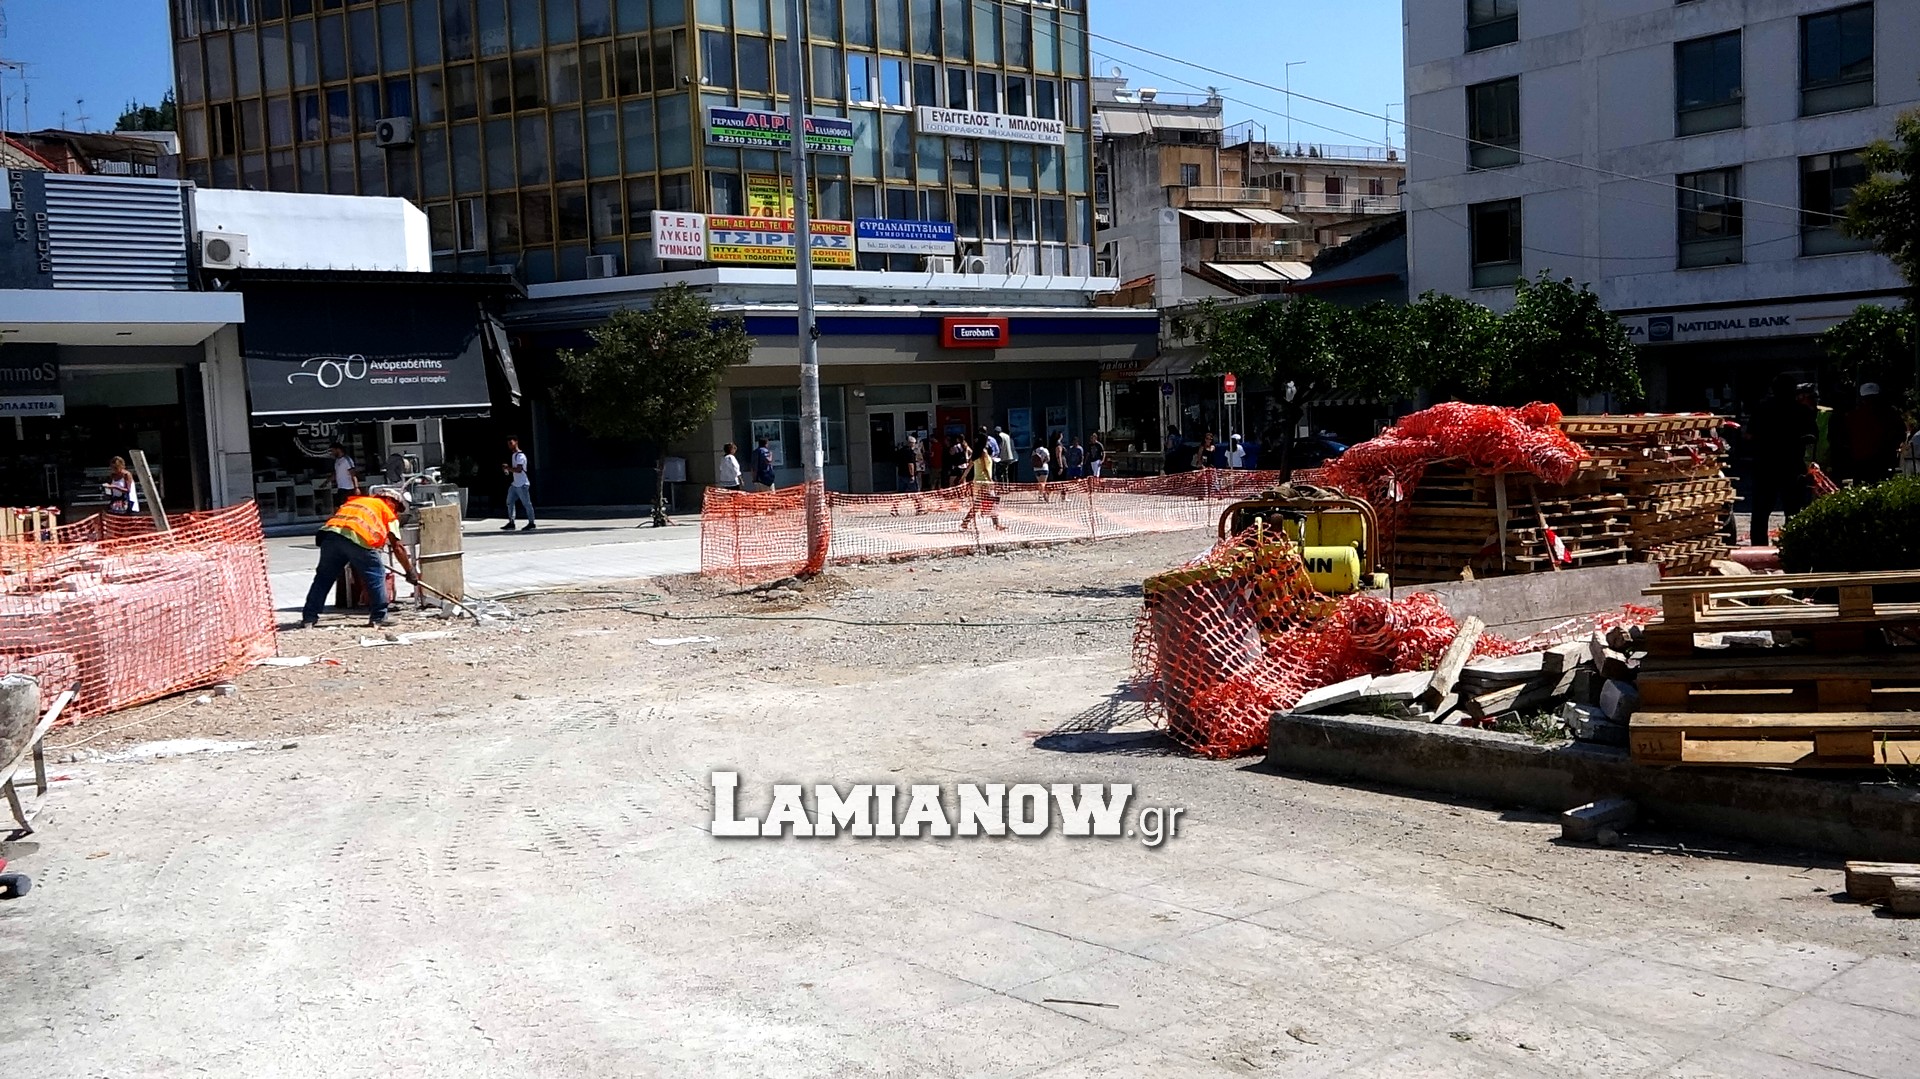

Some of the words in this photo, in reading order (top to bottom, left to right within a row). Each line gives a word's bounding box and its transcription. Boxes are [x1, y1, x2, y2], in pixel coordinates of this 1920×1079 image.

[712, 117, 744, 127] ΓΕΡΑΝΟΙ
[931, 110, 990, 127] ΕΥΑΓΓΕΛΟΣ
[995, 117, 1003, 128] Γ.
[1008, 118, 1062, 134] ΜΠΛΟΥΝΑΣ
[724, 129, 766, 138] ΕΤΑΙΡΕΙΑ
[770, 133, 841, 143] ΜΕΤΜΙΣΕΩΝ
[926, 123, 983, 135] ΤΟΠΟΓΡΑΦΟΣ
[988, 128, 1034, 140] ΜΗΧΑΝΙΚΟΣ
[718, 135, 745, 144] 22310
[10, 170, 28, 241] GATEAUX
[859, 221, 951, 234] ΕΥΡΩΑΝΑΠΤΥΞΙΑΚΗ
[35, 212, 51, 271] DELUXE
[660, 230, 701, 242] ΛΥΚΕΙΟ
[659, 244, 702, 256] ΓΥΜΝΑΣΙΟ
[744, 247, 782, 255] ΦΥΣΙΚΗΣ
[743, 254, 795, 262] ΥΠΟΛΟΓΙΣΤΙΚΗ
[1676, 318, 1745, 333] NATIONAL
[1748, 315, 1790, 328] BANK
[960, 327, 995, 337] Eurobank
